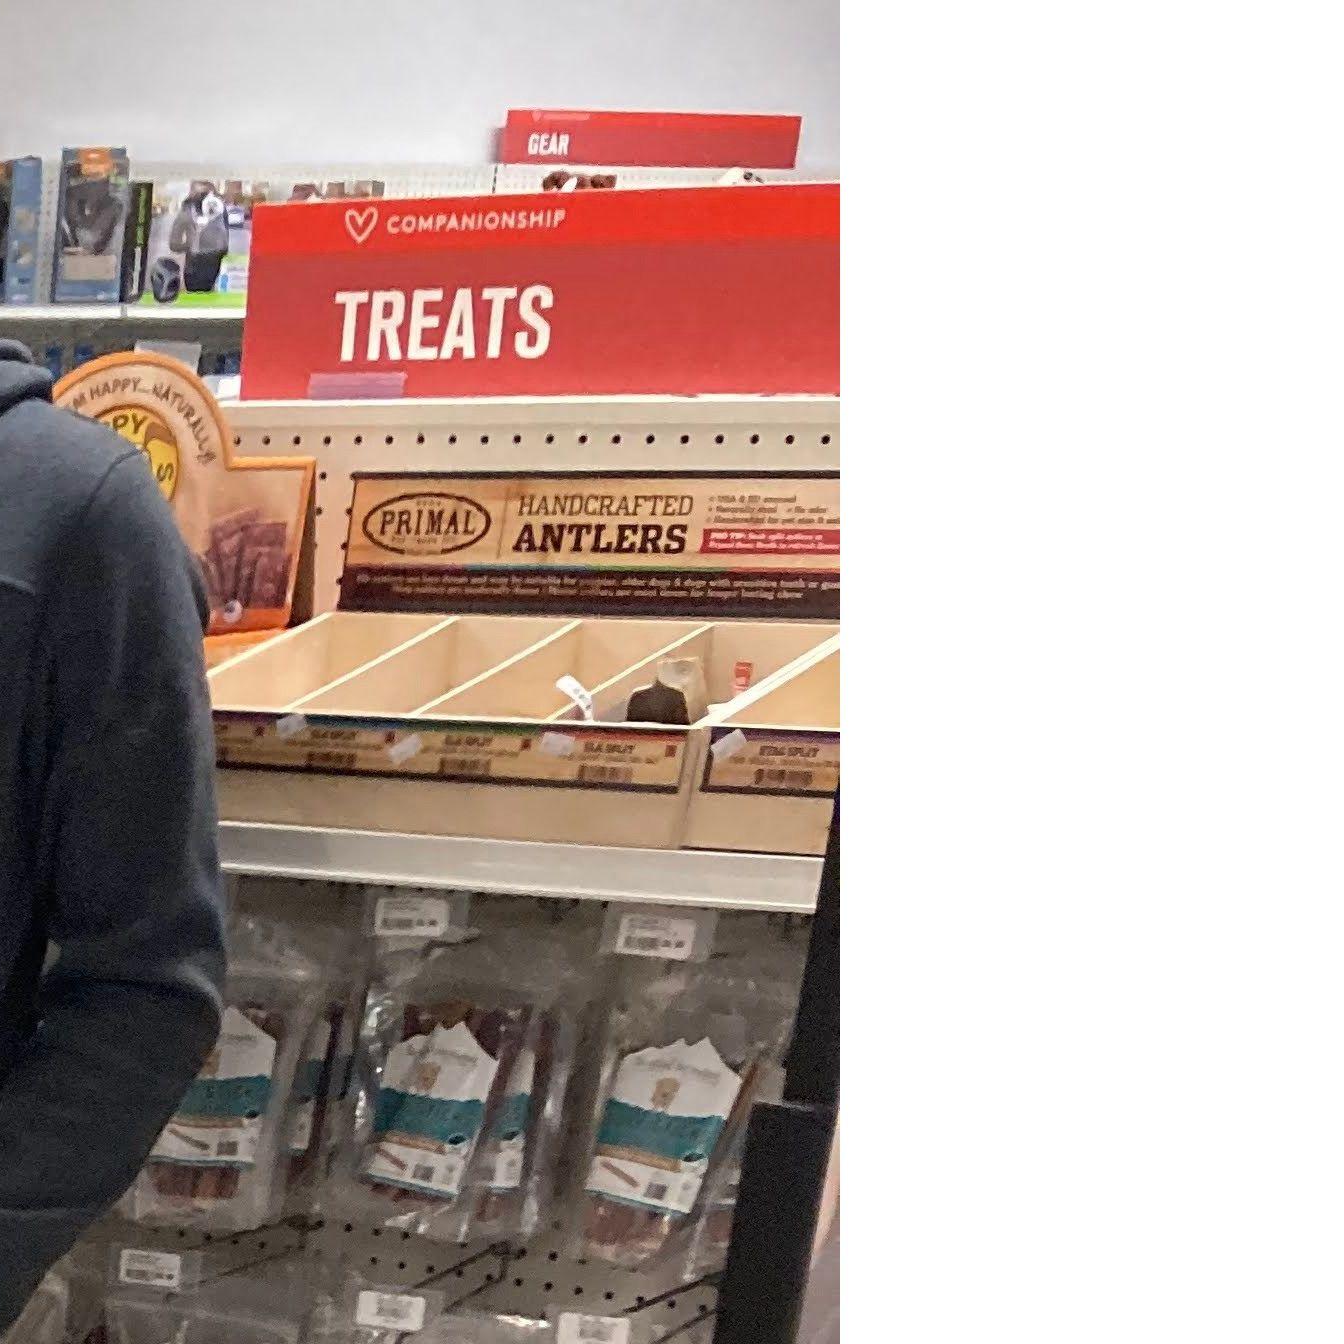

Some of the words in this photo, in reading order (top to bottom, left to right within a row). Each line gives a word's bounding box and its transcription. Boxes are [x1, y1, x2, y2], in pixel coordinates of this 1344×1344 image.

[527, 132, 571, 156] GEAR
[386, 207, 568, 235] COMPANIONSHIP
[334, 283, 555, 363] TREATS
[516, 495, 695, 517] HANDCRAFTED
[380, 507, 478, 537] PRIMAL
[512, 523, 689, 554] ANTLERS
